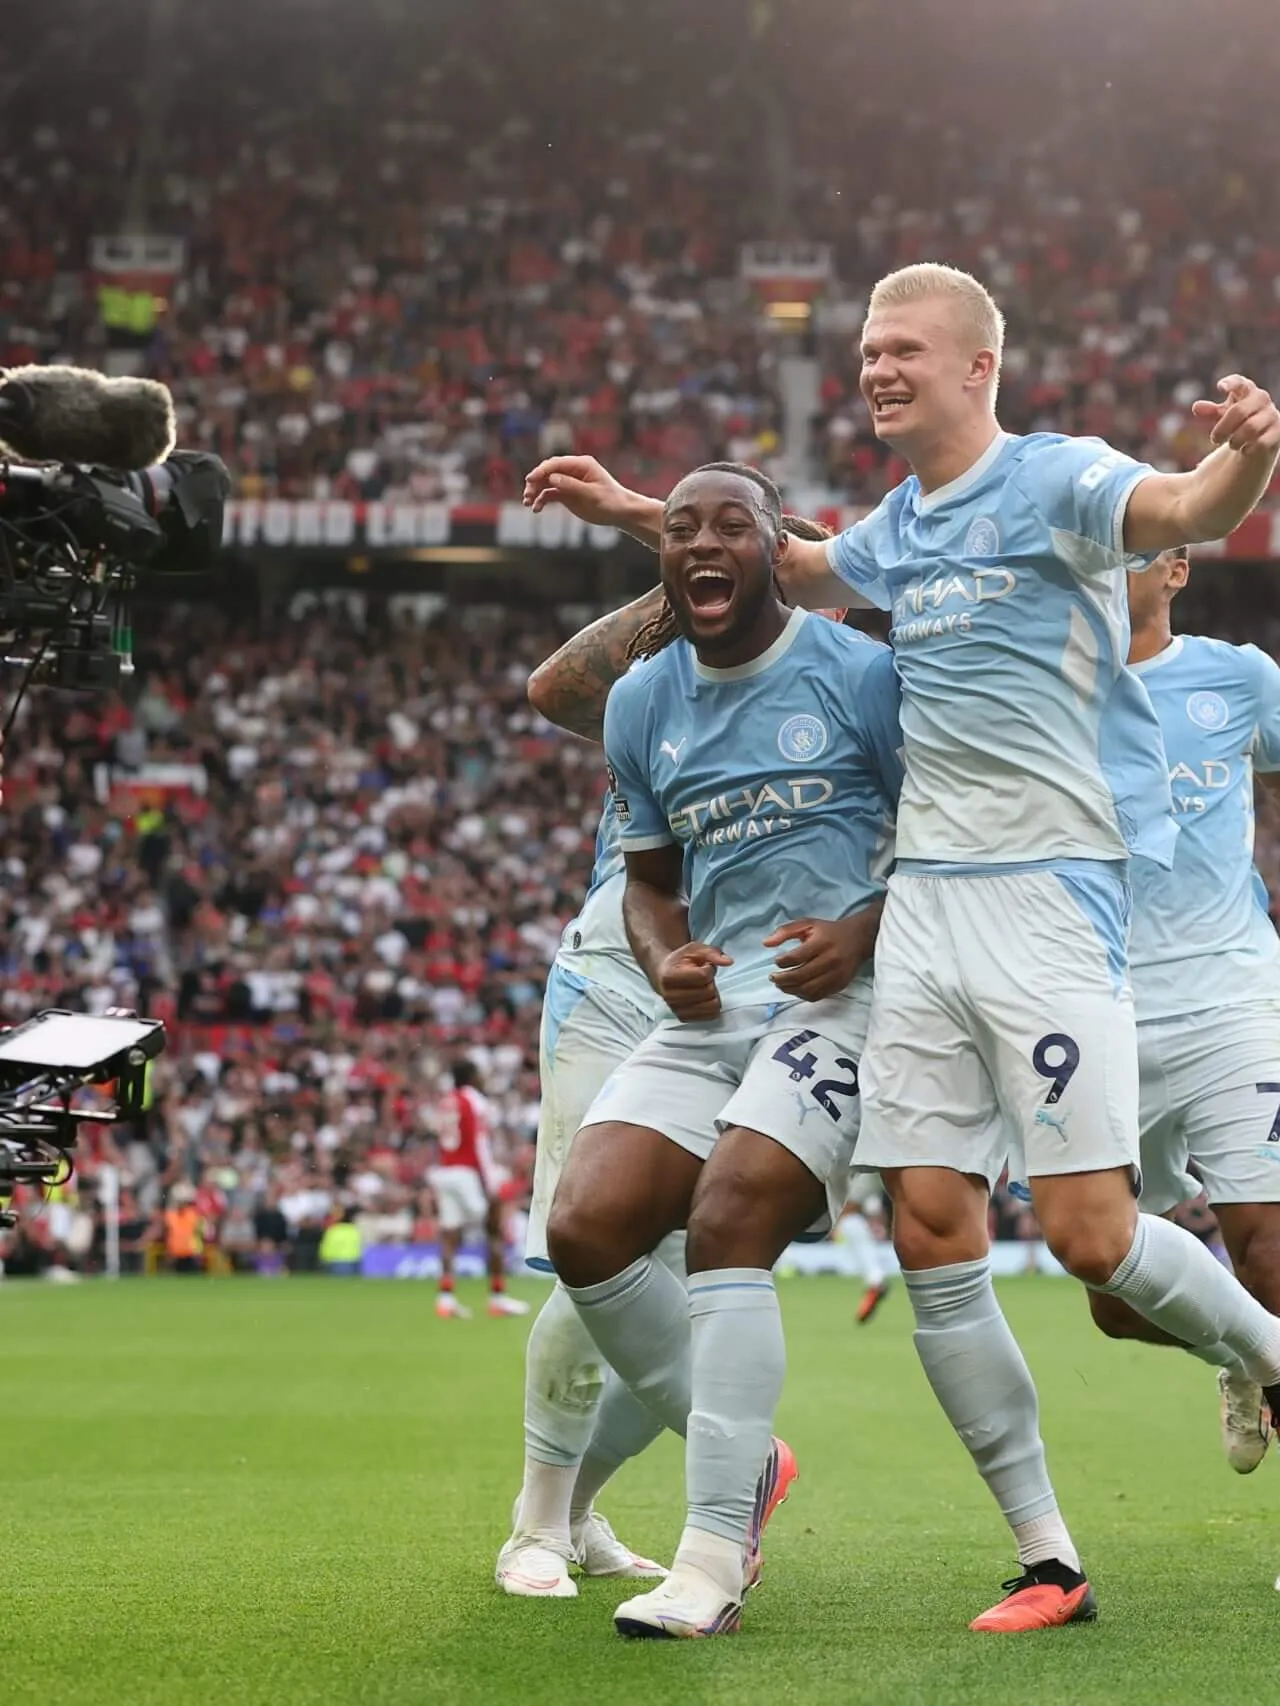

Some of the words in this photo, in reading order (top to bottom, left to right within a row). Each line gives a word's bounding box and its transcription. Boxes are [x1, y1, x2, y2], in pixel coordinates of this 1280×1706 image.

[668, 777, 834, 838] ETIHAD
[694, 815, 792, 848] AIRWAYS
[771, 1029, 860, 1123] 42
[1032, 1033, 1080, 1104] 9
